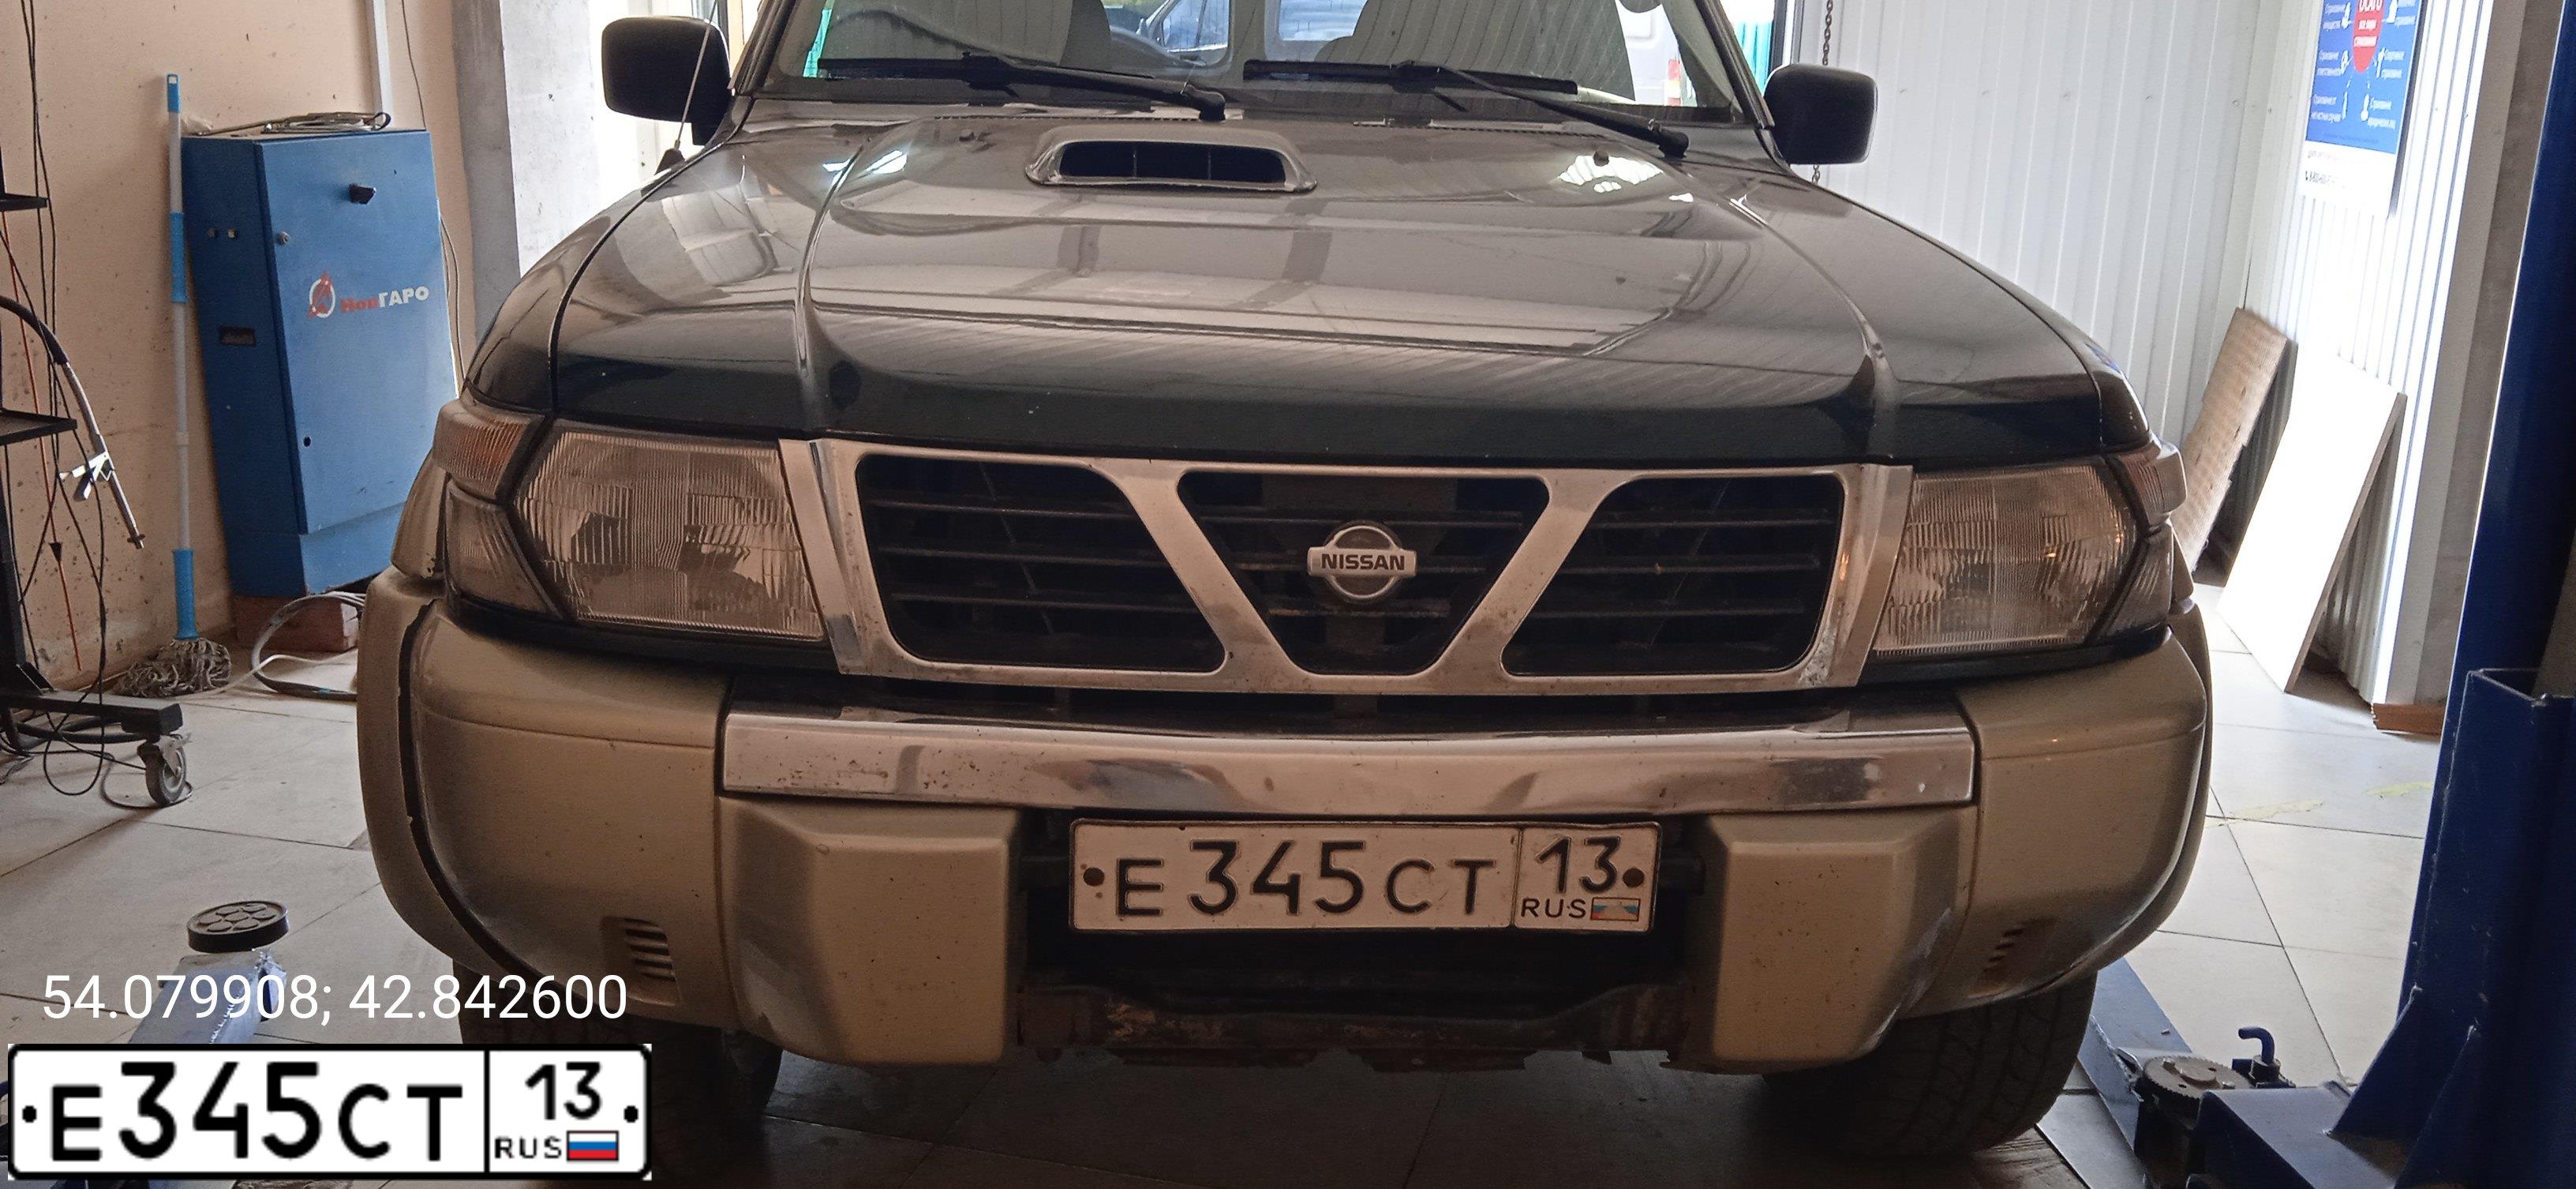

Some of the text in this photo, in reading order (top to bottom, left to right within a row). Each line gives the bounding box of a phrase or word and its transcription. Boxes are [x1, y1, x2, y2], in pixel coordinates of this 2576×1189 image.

[1321, 553, 1405, 571] NISSAN
[1535, 837, 1621, 894] 13
[1521, 897, 1586, 919] RUS
